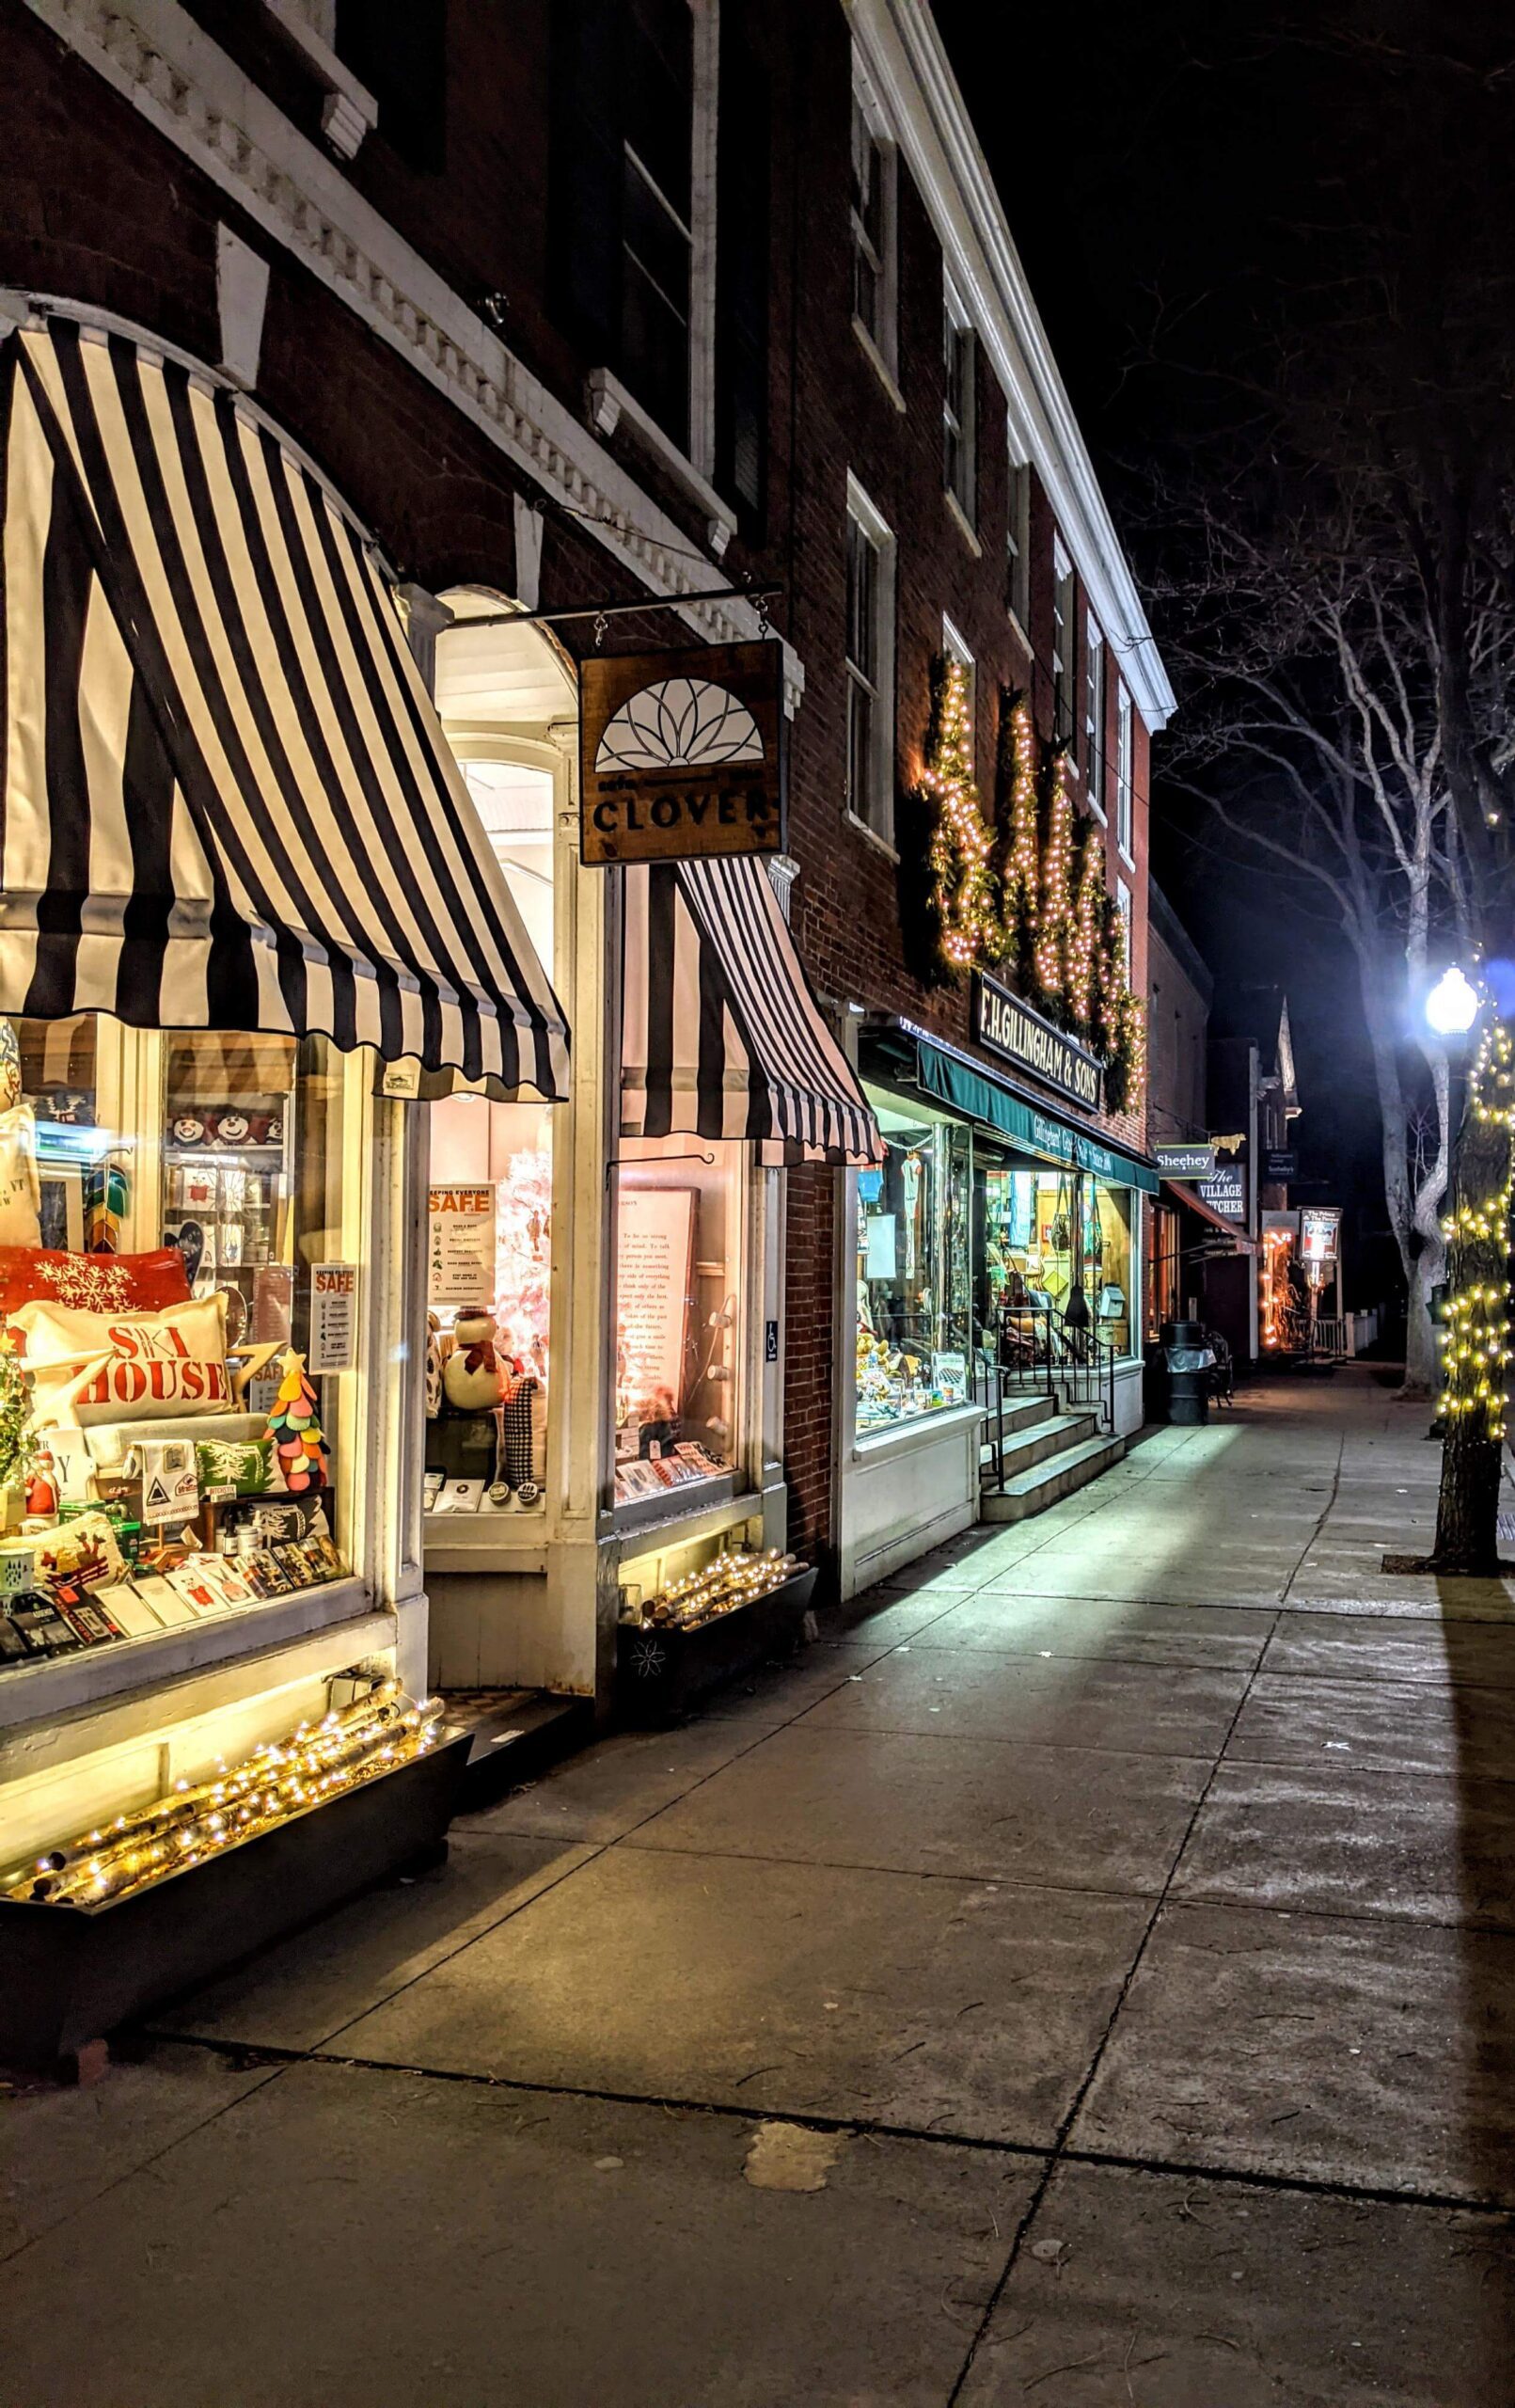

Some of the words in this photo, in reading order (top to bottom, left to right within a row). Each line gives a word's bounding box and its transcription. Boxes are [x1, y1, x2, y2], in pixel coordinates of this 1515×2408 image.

[593, 789, 768, 832] CLOVER
[1064, 1051, 1072, 1087] &
[1074, 1058, 1097, 1103] SONS
[1157, 1154, 1209, 1169] Sheehey
[1209, 1169, 1233, 1182] The
[1200, 1184, 1241, 1197] VILLAGE
[429, 1195, 489, 1212] SAFE
[316, 1275, 354, 1292] SAFE
[108, 1326, 191, 1359] SKI
[71, 1359, 229, 1404] HOUSE
